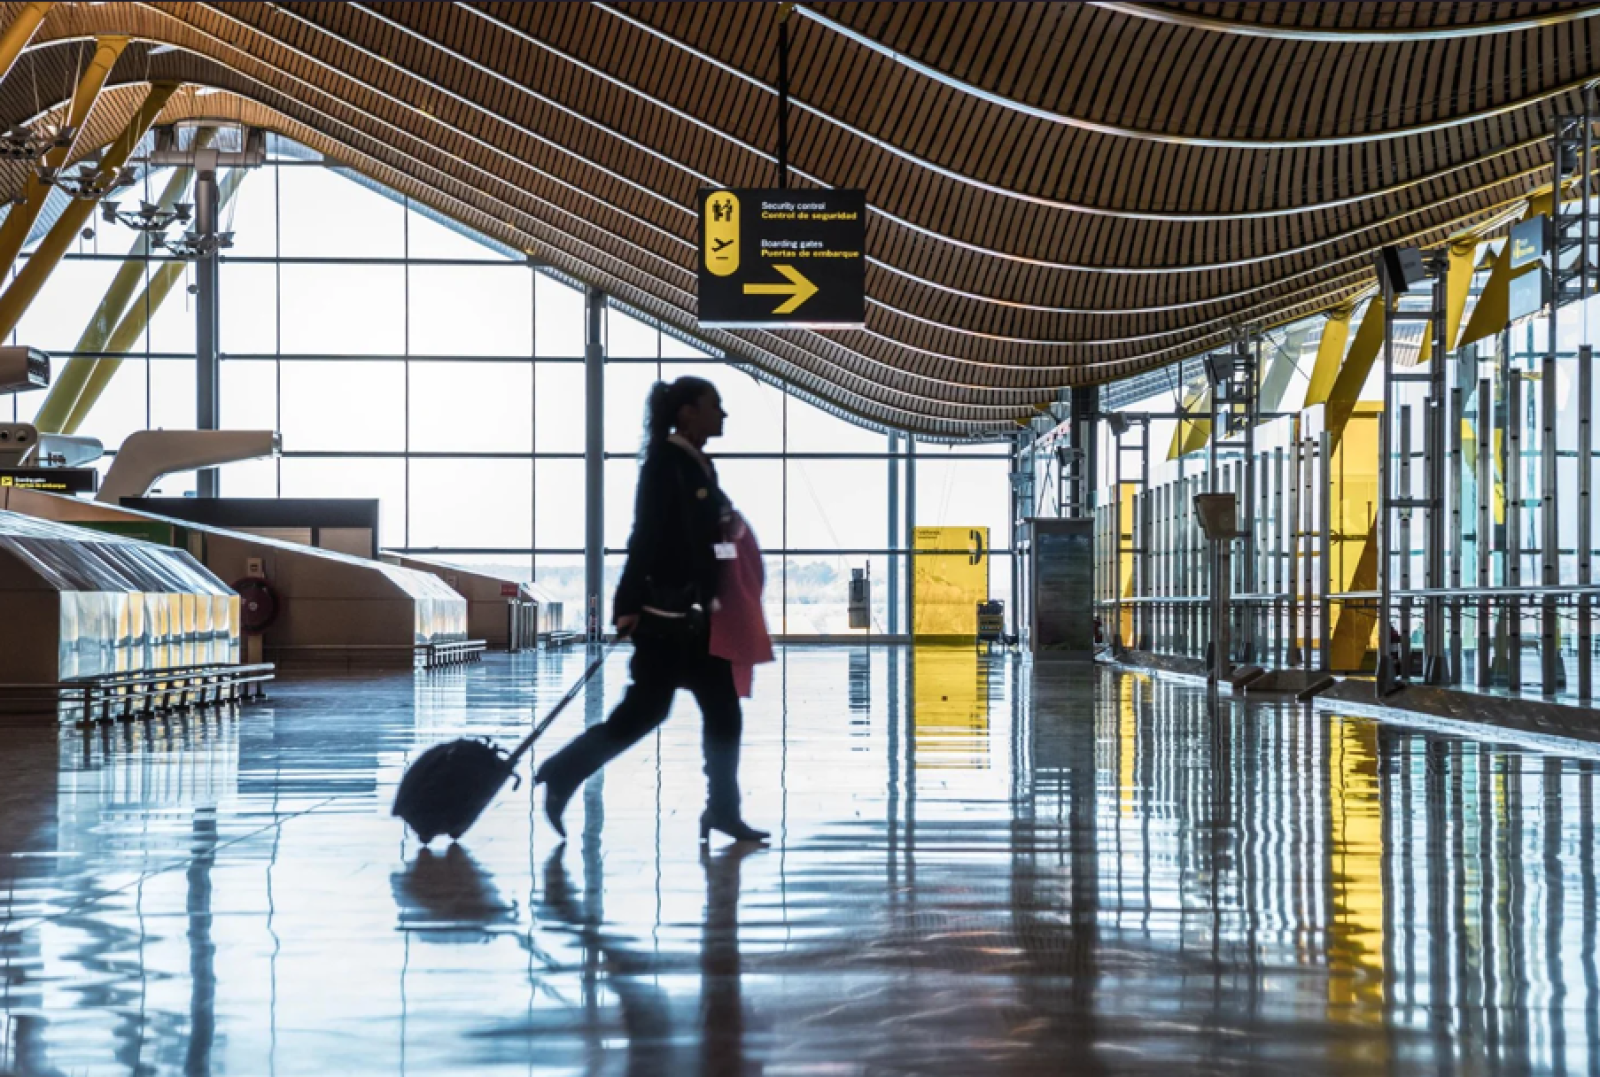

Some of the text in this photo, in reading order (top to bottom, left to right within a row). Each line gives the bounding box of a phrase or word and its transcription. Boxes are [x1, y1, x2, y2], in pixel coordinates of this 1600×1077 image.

[762, 202, 826, 211] Security control
[762, 211, 857, 221] Control de seguridad
[761, 239, 823, 249] Boarding gates
[761, 249, 859, 259] Puertas de embarque
